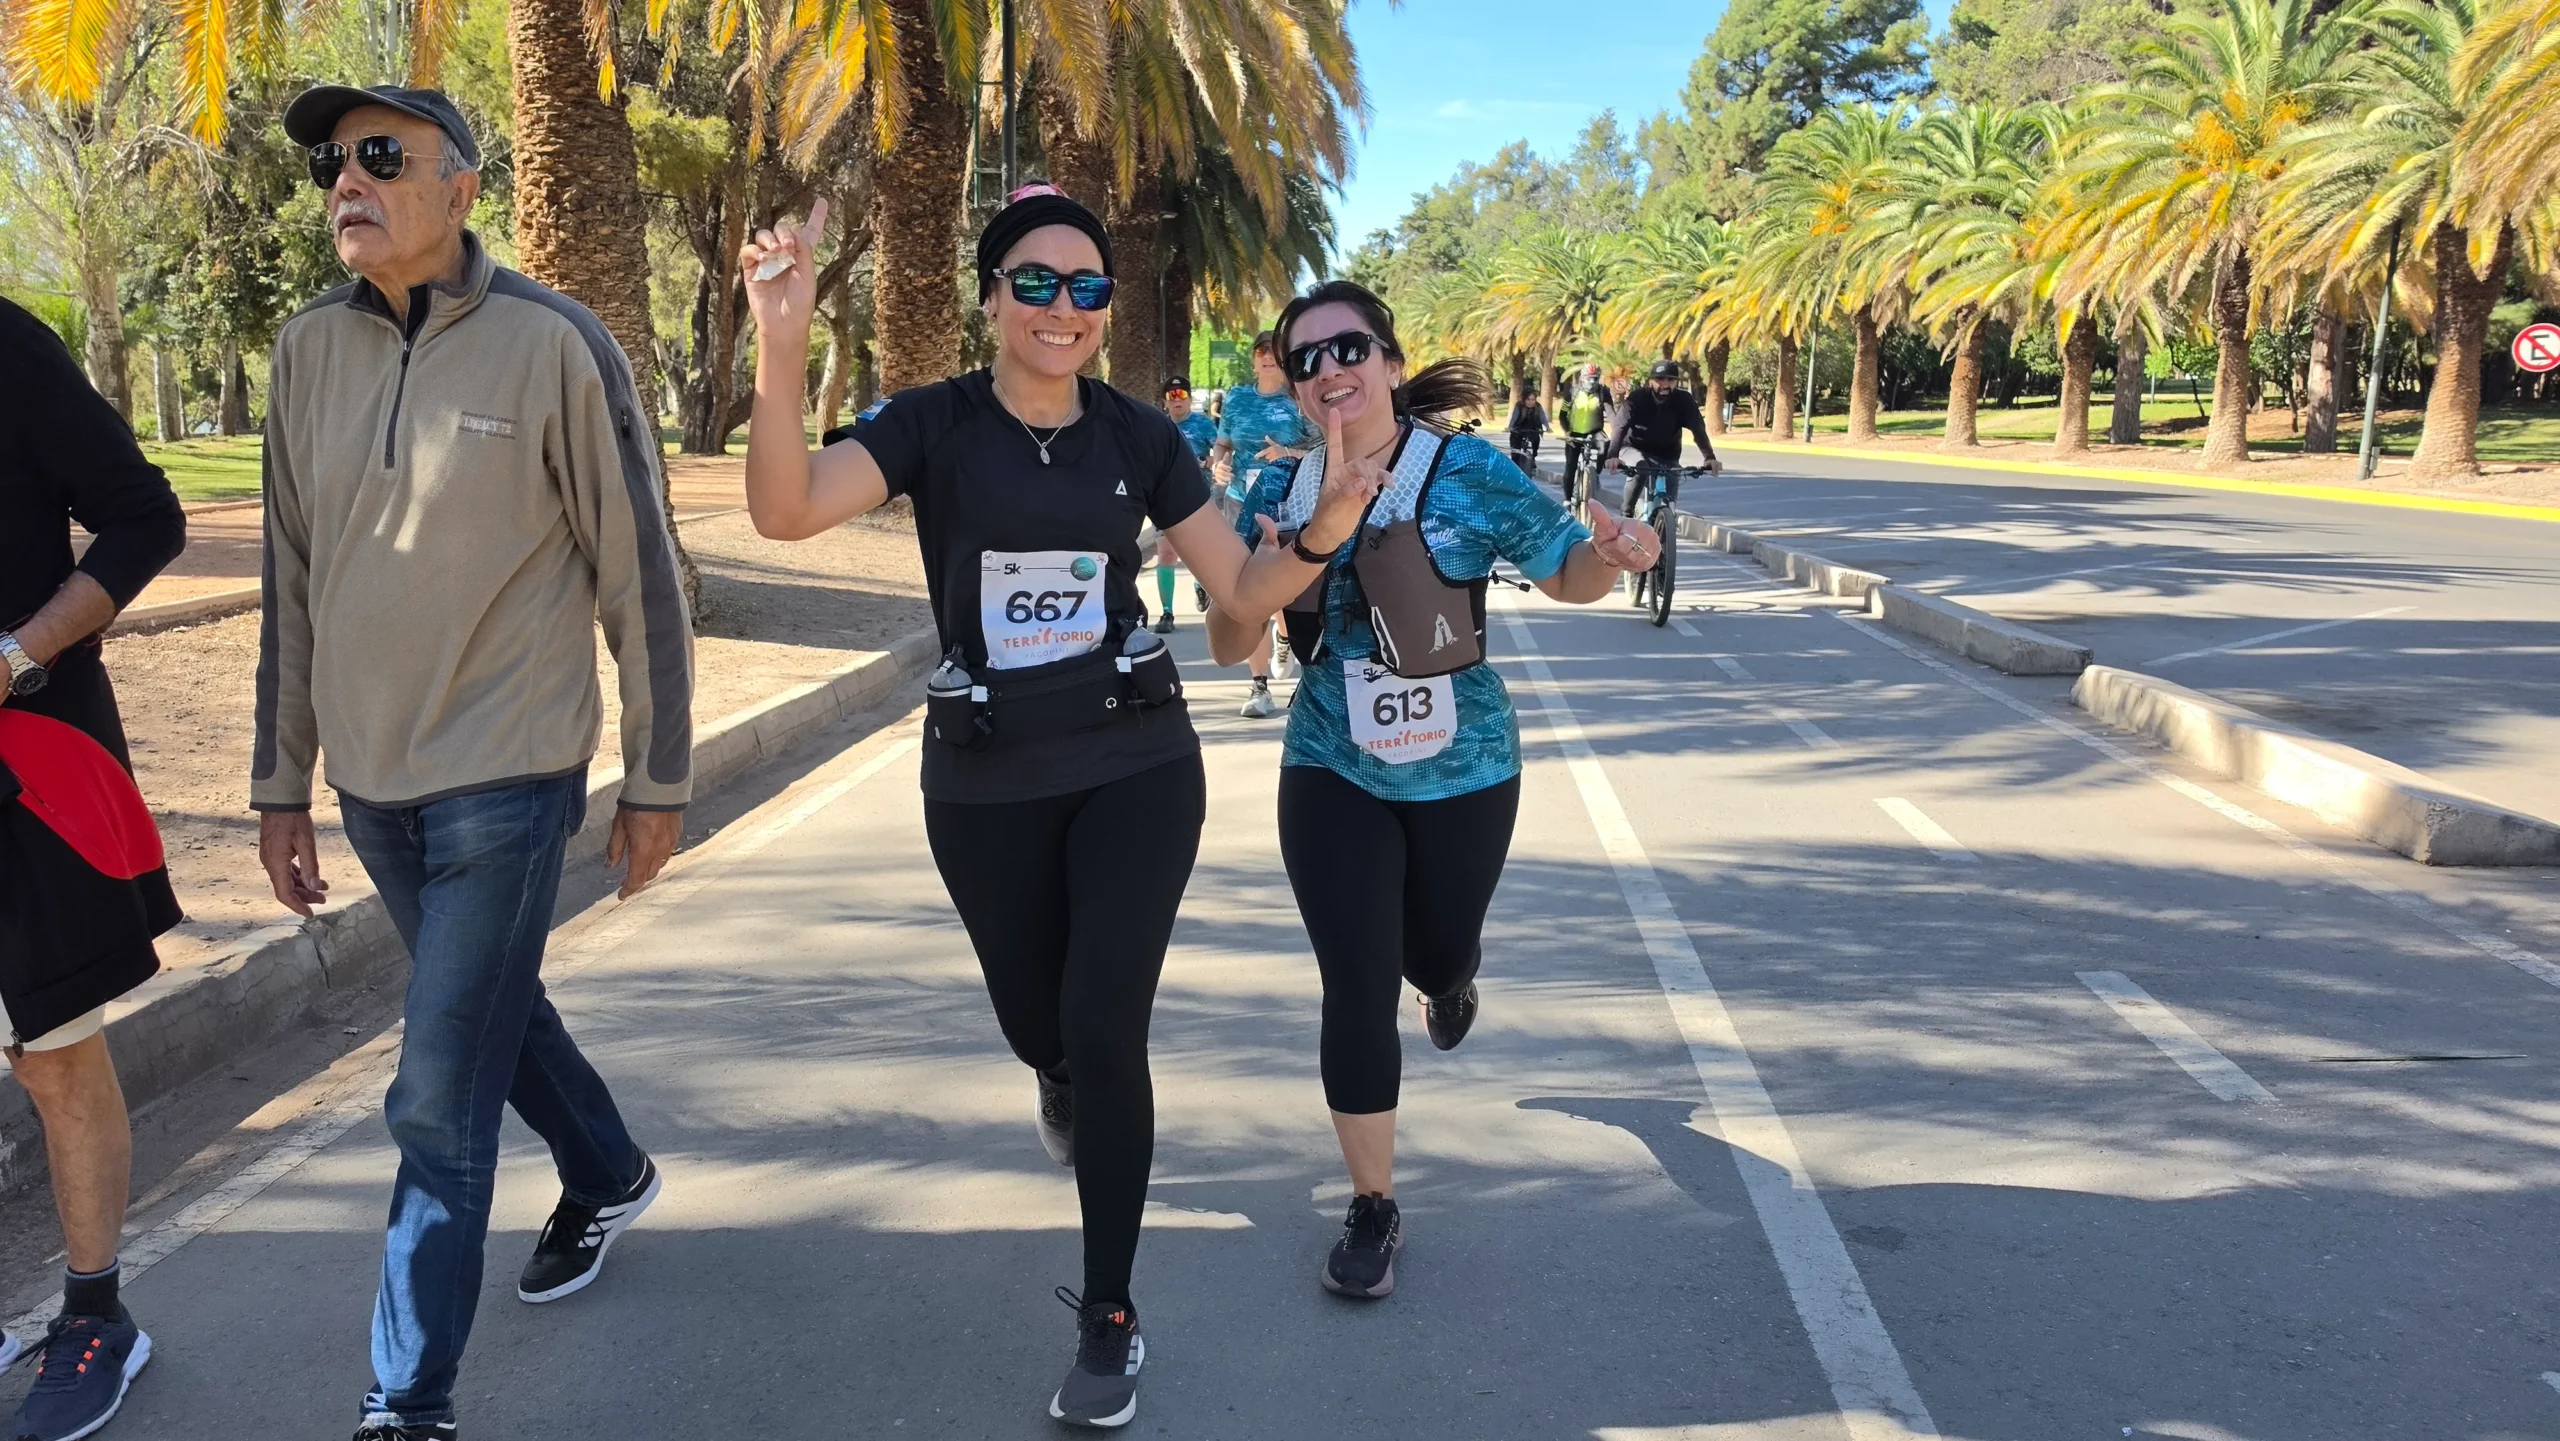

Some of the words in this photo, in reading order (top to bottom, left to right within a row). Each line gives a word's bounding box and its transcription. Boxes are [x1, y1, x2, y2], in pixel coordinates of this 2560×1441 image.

[1003, 562, 1022, 576] 5k
[1005, 590, 1088, 624] 667
[1003, 627, 1095, 649] TERRITORIO
[1372, 686, 1433, 726] 613
[1368, 729, 1447, 750] TERRITORIO
